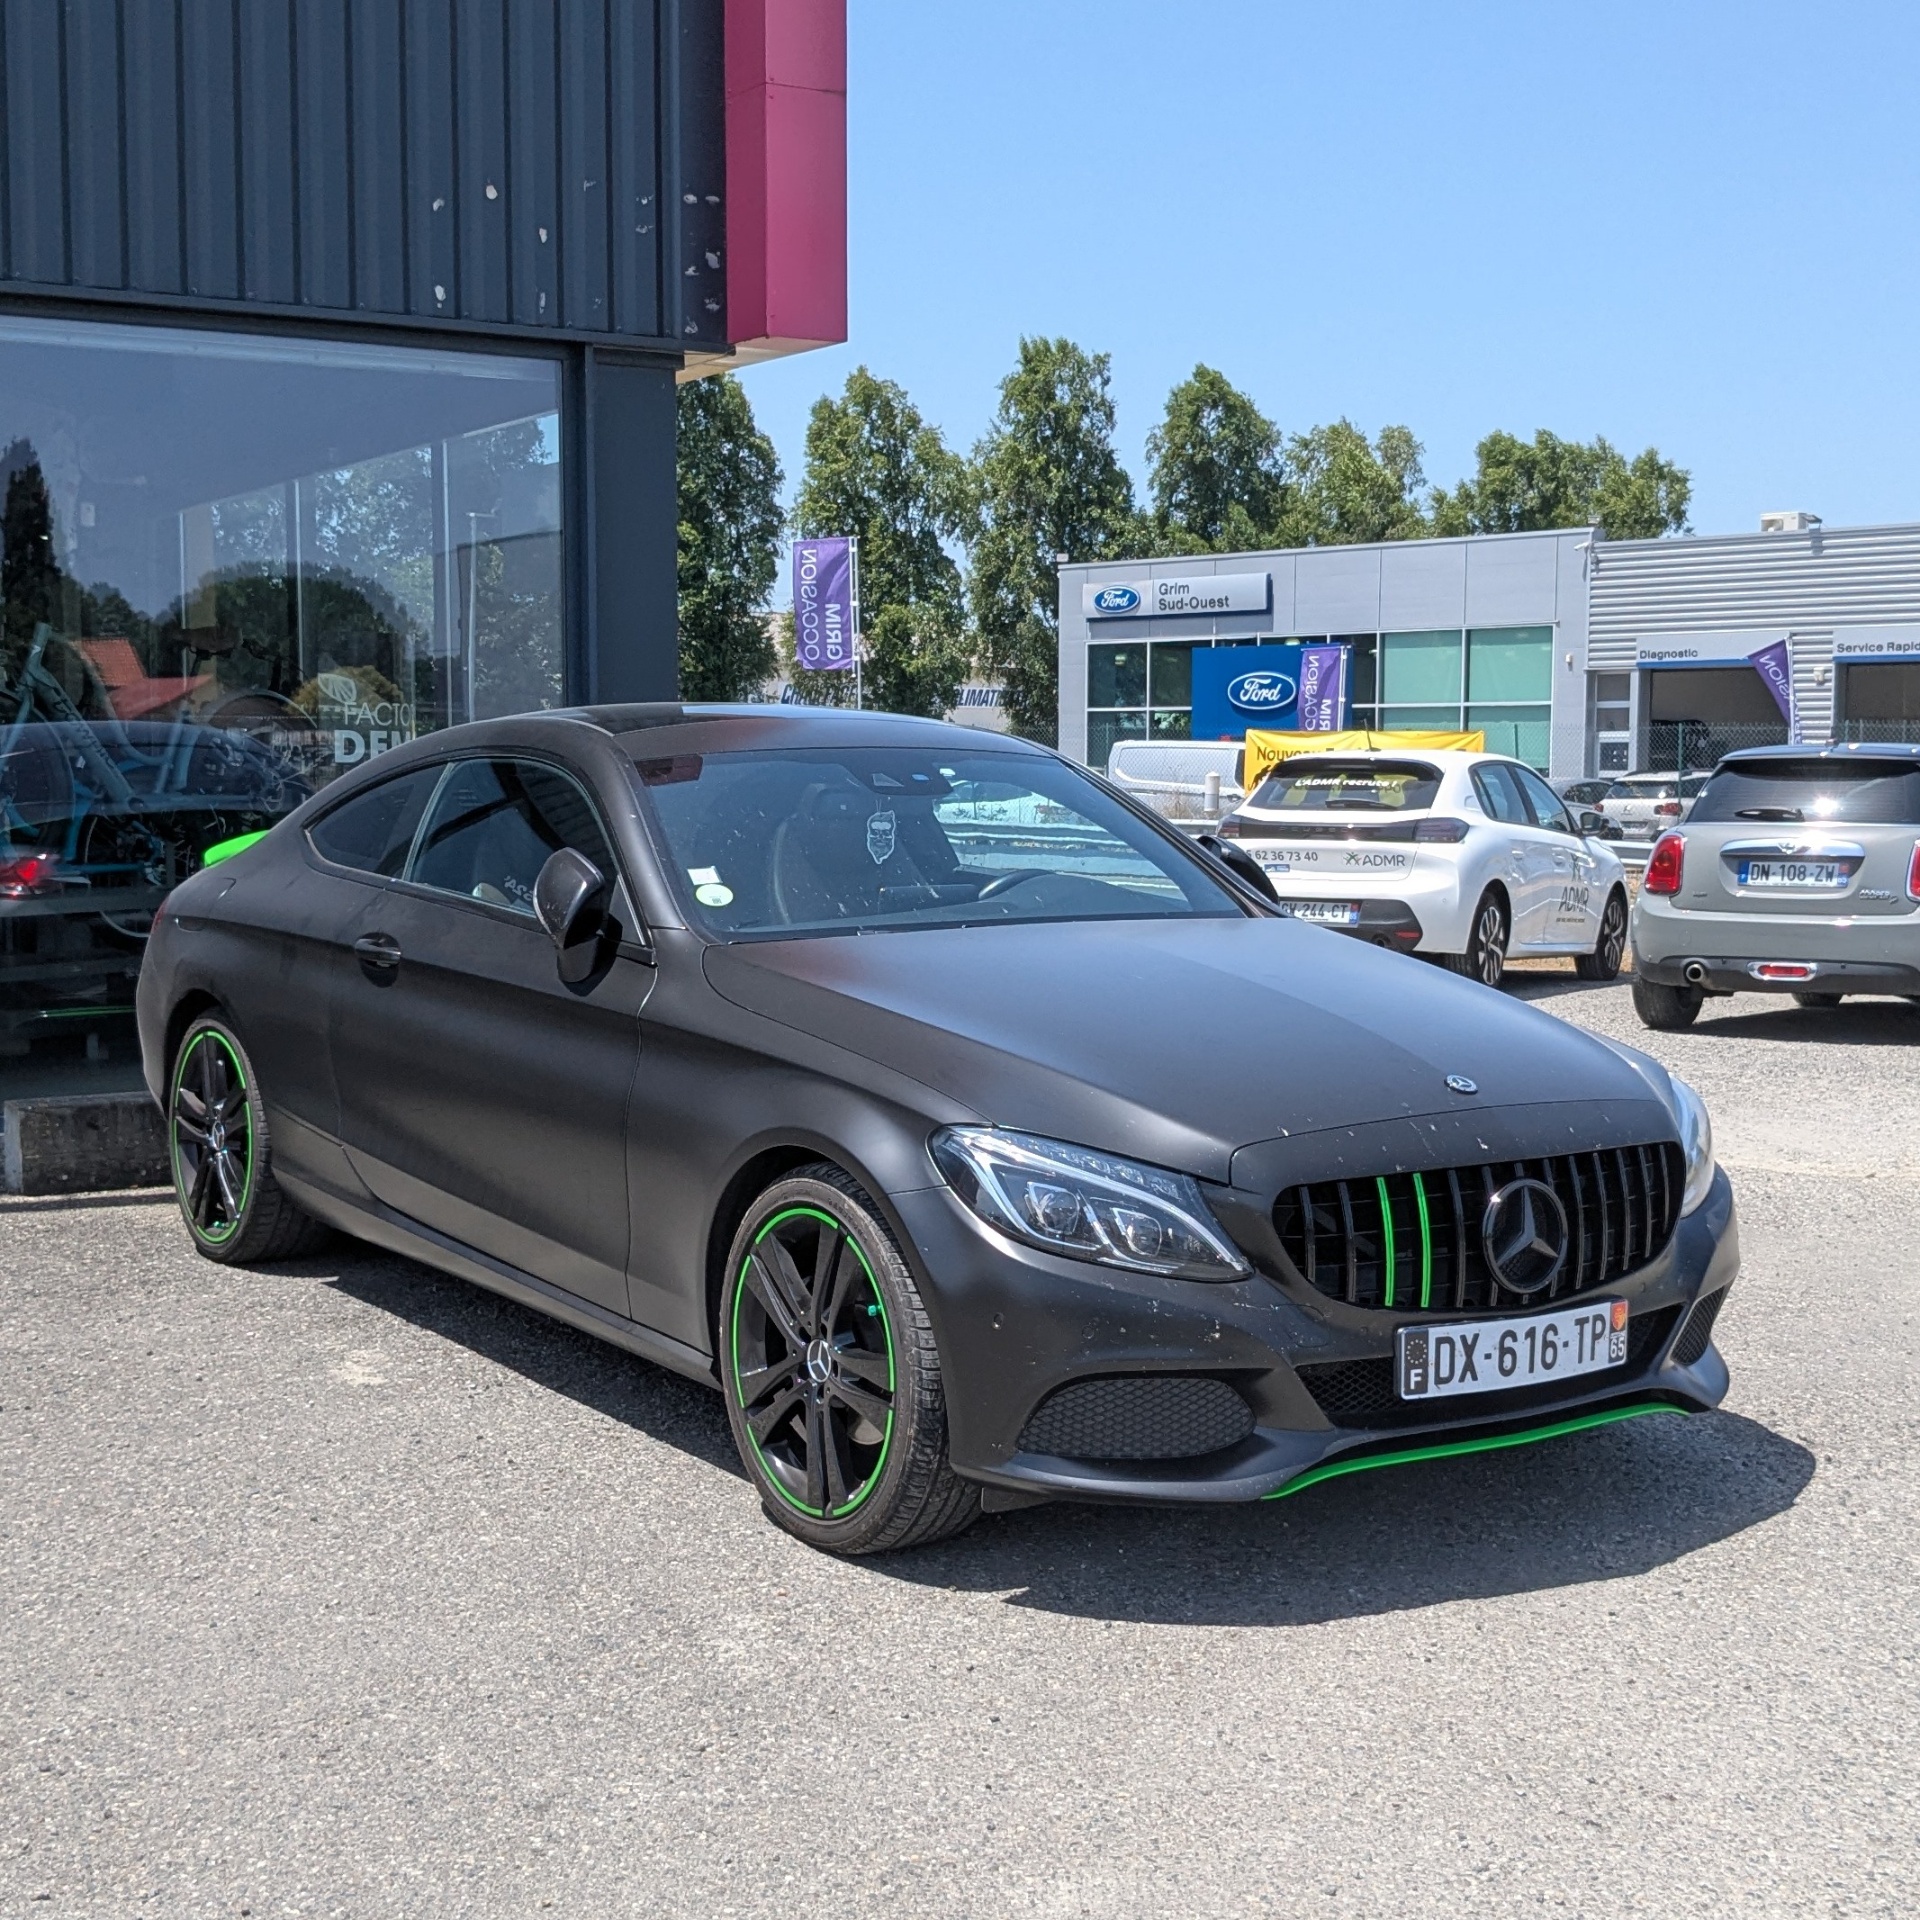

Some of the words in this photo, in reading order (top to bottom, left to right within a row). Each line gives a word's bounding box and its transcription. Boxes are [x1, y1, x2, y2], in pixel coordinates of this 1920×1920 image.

[1158, 582, 1190, 596] Grim
[1101, 589, 1130, 608] Ford
[1158, 595, 1230, 611] Sud-Ouest
[1639, 648, 1698, 661] Diagnostic
[1837, 643, 1884, 653] Service
[1239, 677, 1282, 701] Ford
[344, 701, 413, 727] FACTO
[1256, 745, 1321, 761] Nouv
[1255, 850, 1269, 861] 62
[1270, 850, 1285, 861] 36
[1286, 851, 1302, 862] 73
[1303, 851, 1319, 862] 40
[1362, 854, 1406, 867] ADMR
[1750, 863, 1836, 883] DN-108-ZW
[1558, 886, 1590, 913] ADMR
[1410, 1368, 1423, 1390] F
[1433, 1312, 1607, 1387] DX-616-TP
[1609, 1337, 1625, 1359] 65
